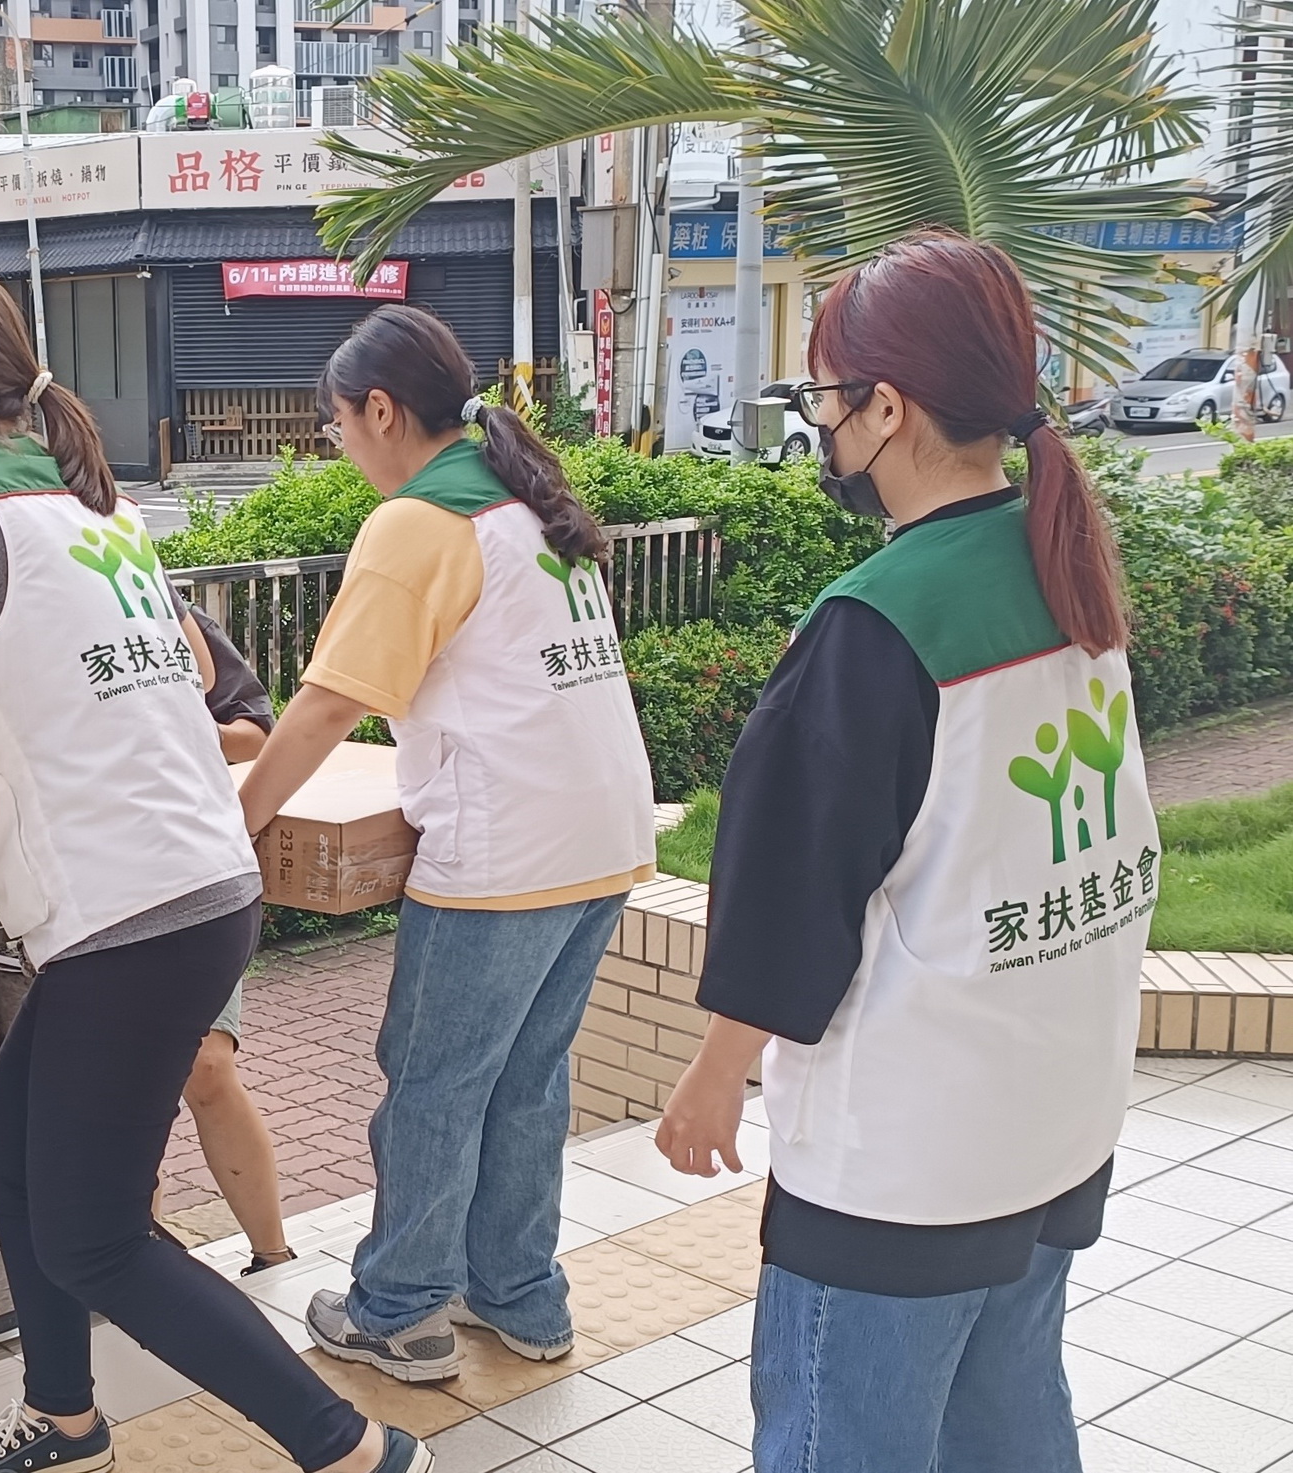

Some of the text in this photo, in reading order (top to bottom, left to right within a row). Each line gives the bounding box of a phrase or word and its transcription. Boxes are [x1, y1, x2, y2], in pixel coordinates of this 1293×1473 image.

[168, 149, 264, 194] 品格
[61, 192, 90, 202] HOTPOT
[94, 683, 135, 702] Taiwan
[136, 677, 158, 689] Fund
[158, 674, 170, 684] for
[551, 679, 579, 691] Taiwan
[579, 674, 595, 685] Fund
[279, 829, 294, 868] 23.8
[319, 833, 329, 870] acer
[351, 878, 380, 897] Acer
[984, 845, 1158, 954] 家扶基金會
[989, 955, 1035, 974] Taiwan
[1038, 942, 1067, 963] Fund
[1069, 938, 1083, 953] for
[1084, 922, 1119, 946] Children
[1119, 913, 1133, 928] and
